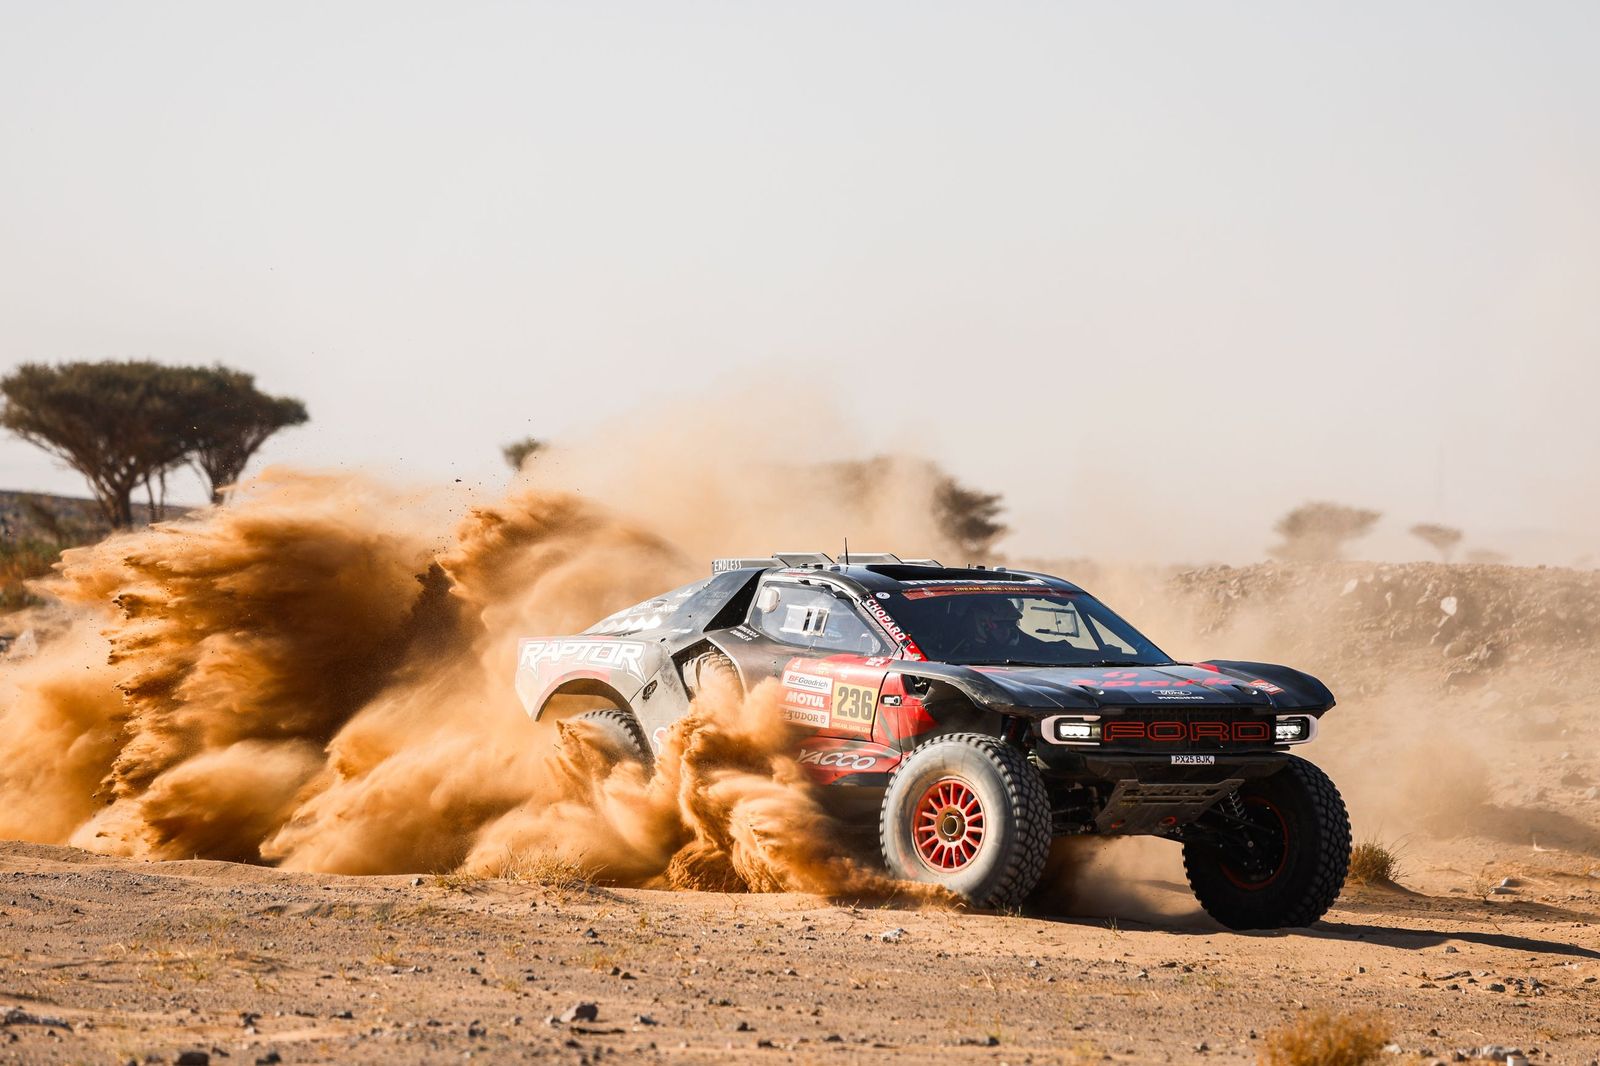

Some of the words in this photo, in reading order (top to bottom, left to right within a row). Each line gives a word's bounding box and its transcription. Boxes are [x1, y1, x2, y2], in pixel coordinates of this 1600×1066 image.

[714, 559, 742, 571] ENDLESS
[866, 599, 907, 641] CHOPARD
[520, 640, 646, 685] RAPTOR
[789, 675, 829, 688] BFGoodrich
[785, 691, 825, 707] MOTUL
[837, 686, 873, 720] 236
[787, 709, 819, 722] TUDOR
[1103, 721, 1270, 741] FORD
[798, 749, 877, 770] YACCO
[1175, 755, 1195, 763] PX25
